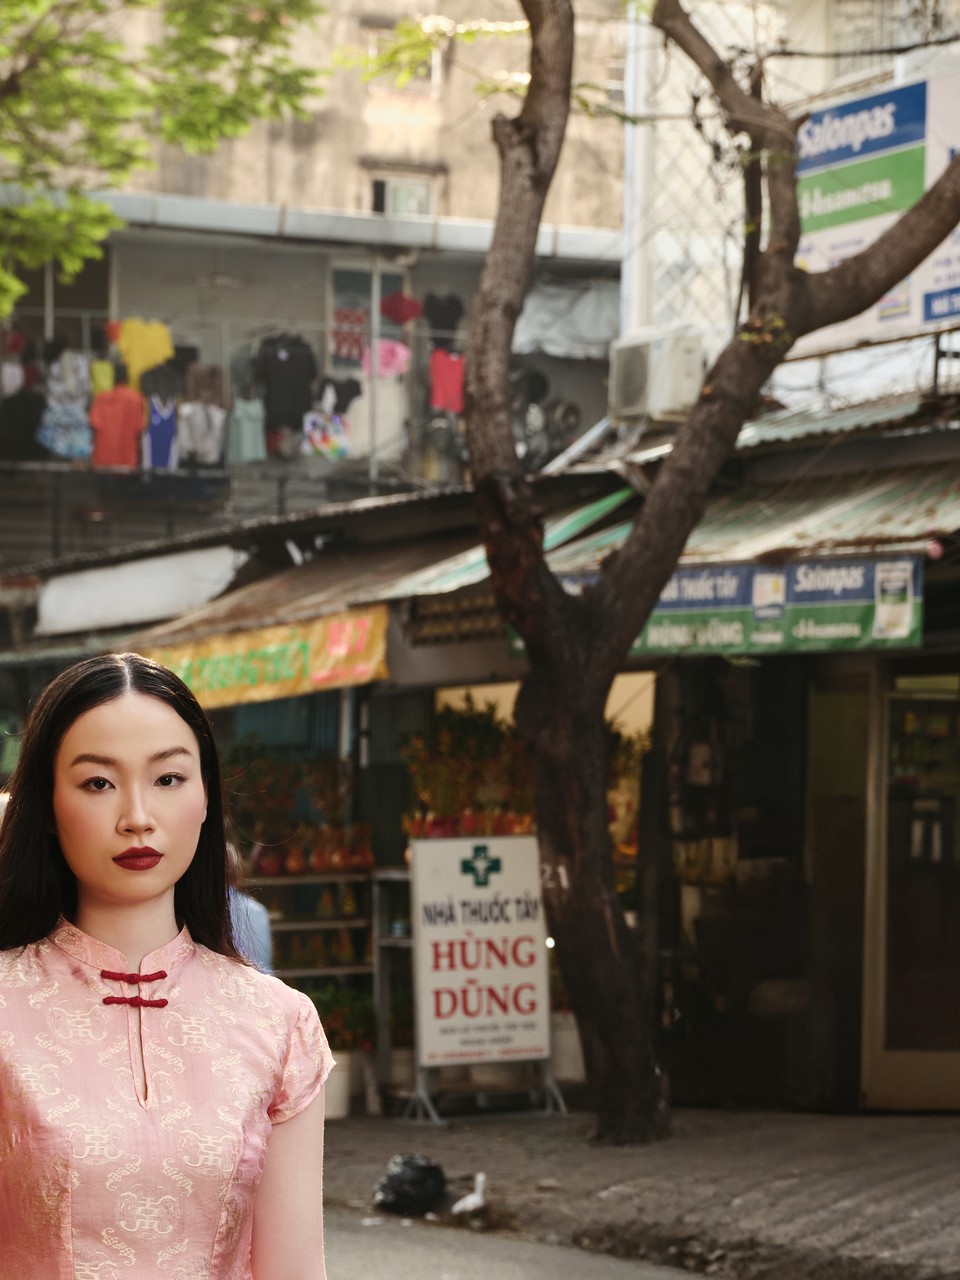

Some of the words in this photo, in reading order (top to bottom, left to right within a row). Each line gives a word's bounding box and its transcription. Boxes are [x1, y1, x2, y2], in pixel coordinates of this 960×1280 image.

[798, 103, 896, 157] Salonpas
[423, 894, 456, 925] NHÀ
[461, 891, 511, 923] THUỐC
[514, 892, 540, 921] TÂY
[432, 930, 536, 972] HÙNG
[433, 977, 537, 1019] DŨNG
